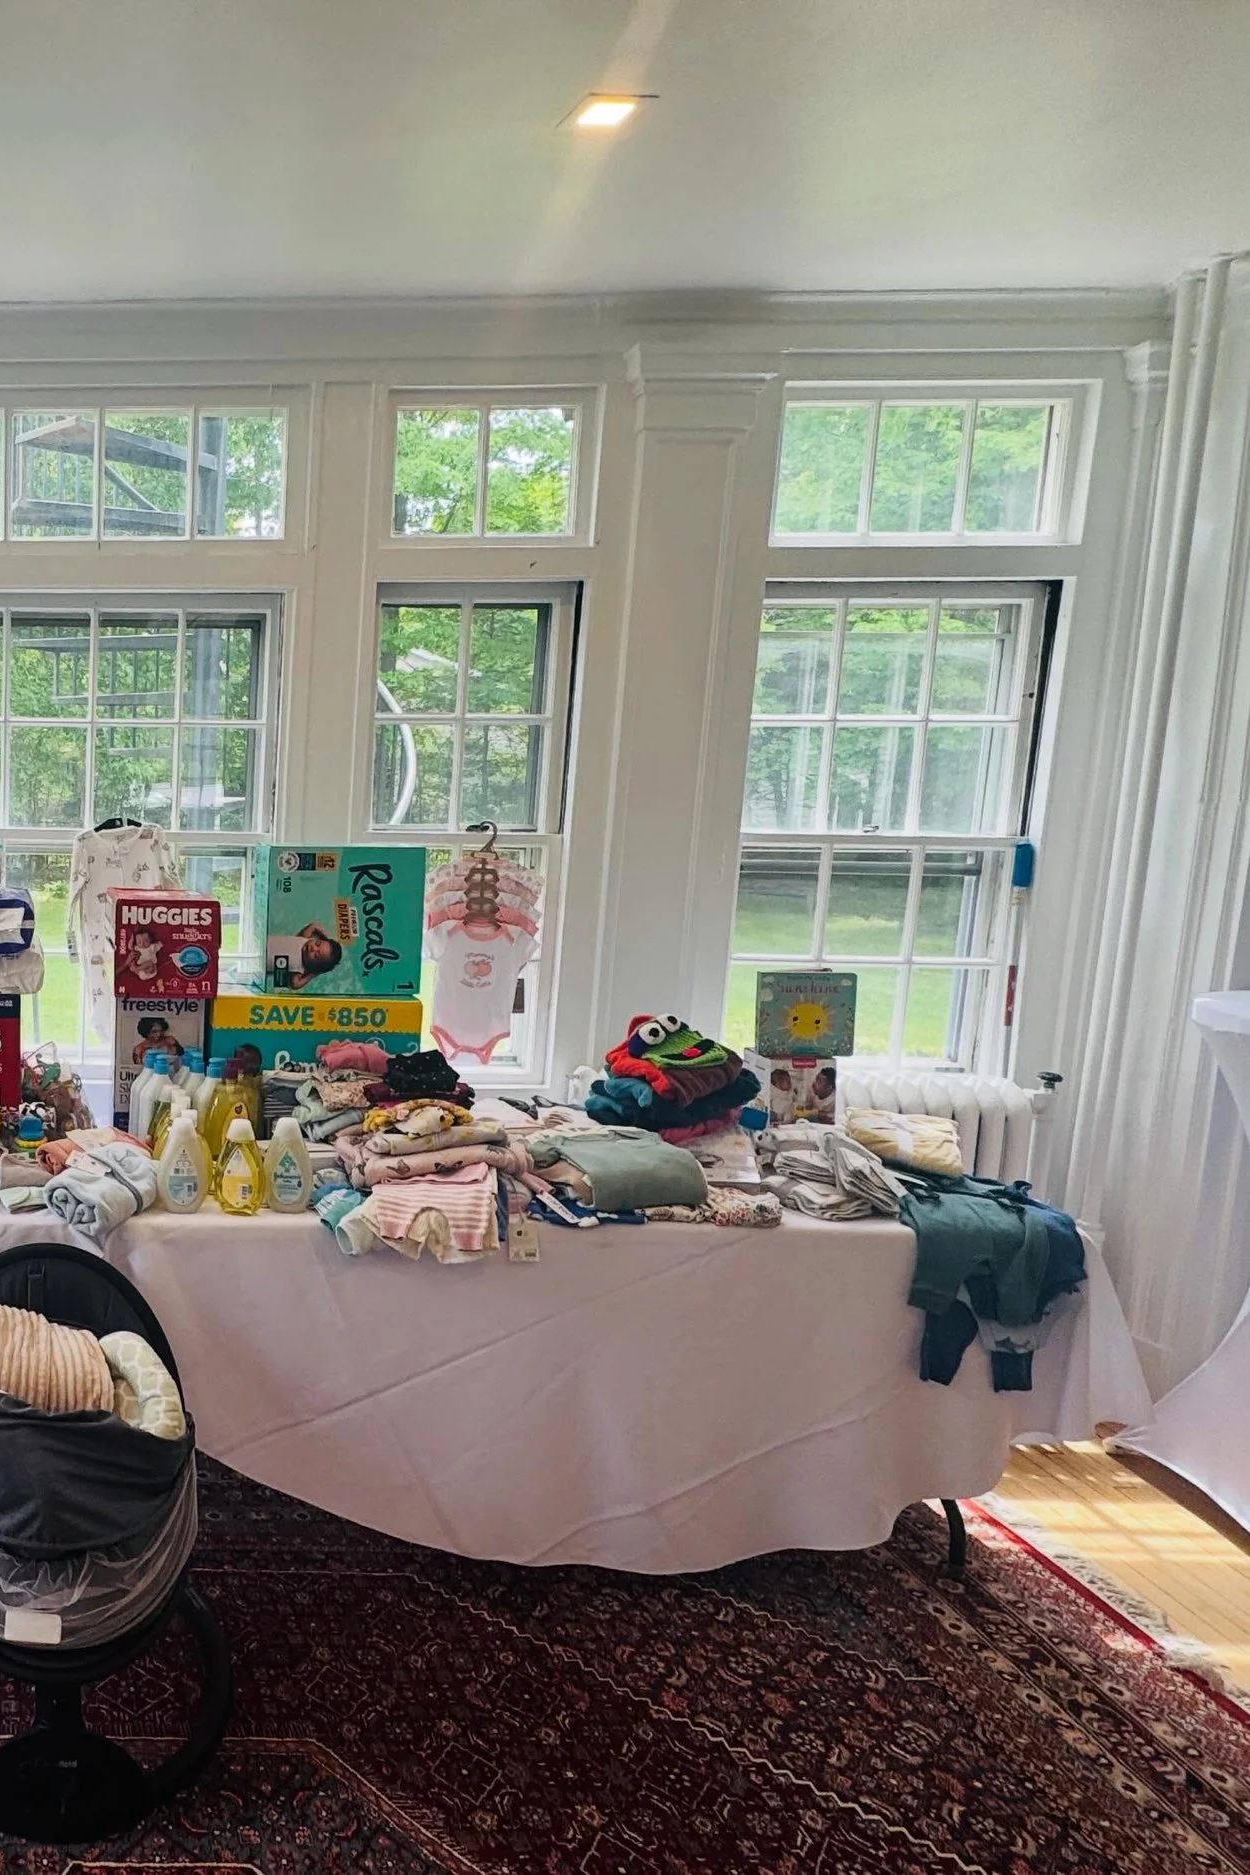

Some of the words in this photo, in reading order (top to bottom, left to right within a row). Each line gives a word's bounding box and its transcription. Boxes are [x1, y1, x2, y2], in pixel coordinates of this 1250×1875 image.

[282, 876, 292, 894] 108
[121, 905, 213, 926] HUGGIES
[337, 903, 350, 941] DIAPERS
[348, 863, 400, 971] Rascals
[396, 981, 414, 990] 1
[121, 997, 199, 1016] freestyle
[249, 1004, 315, 1026] SAVE
